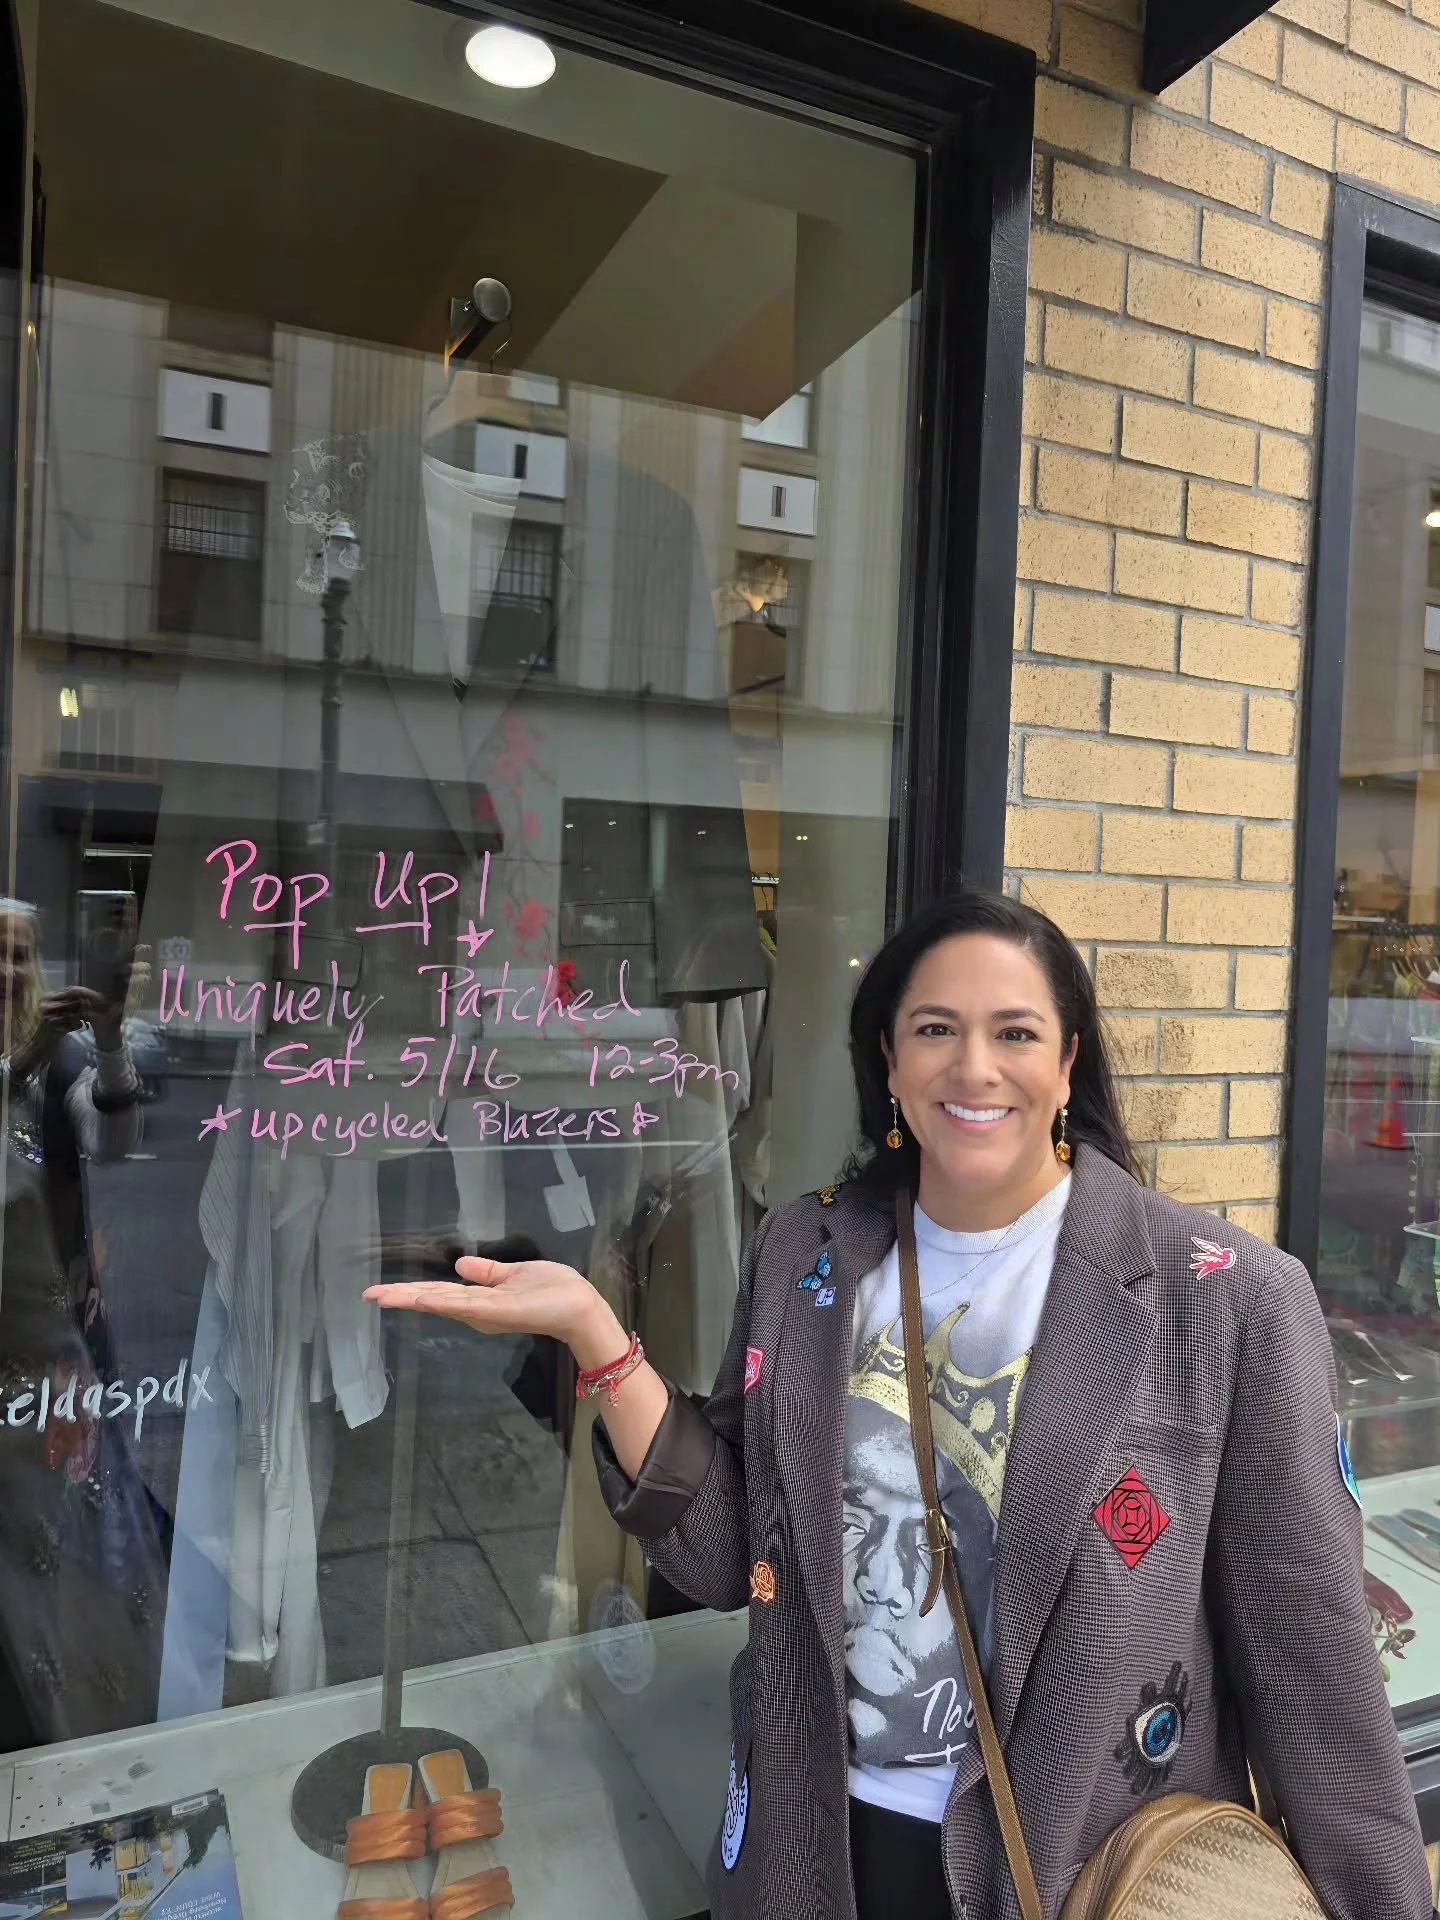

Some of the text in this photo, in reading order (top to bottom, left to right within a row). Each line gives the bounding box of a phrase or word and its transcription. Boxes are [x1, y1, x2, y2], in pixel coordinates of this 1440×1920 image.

[205, 839, 494, 970] Pop Up!
[158, 958, 642, 1051] Uniquely Patched
[262, 1022, 740, 1098] Sat. 5/16 12-3pm
[472, 1100, 622, 1143] Blazers
[0, 1357, 214, 1444] eldaspdx
